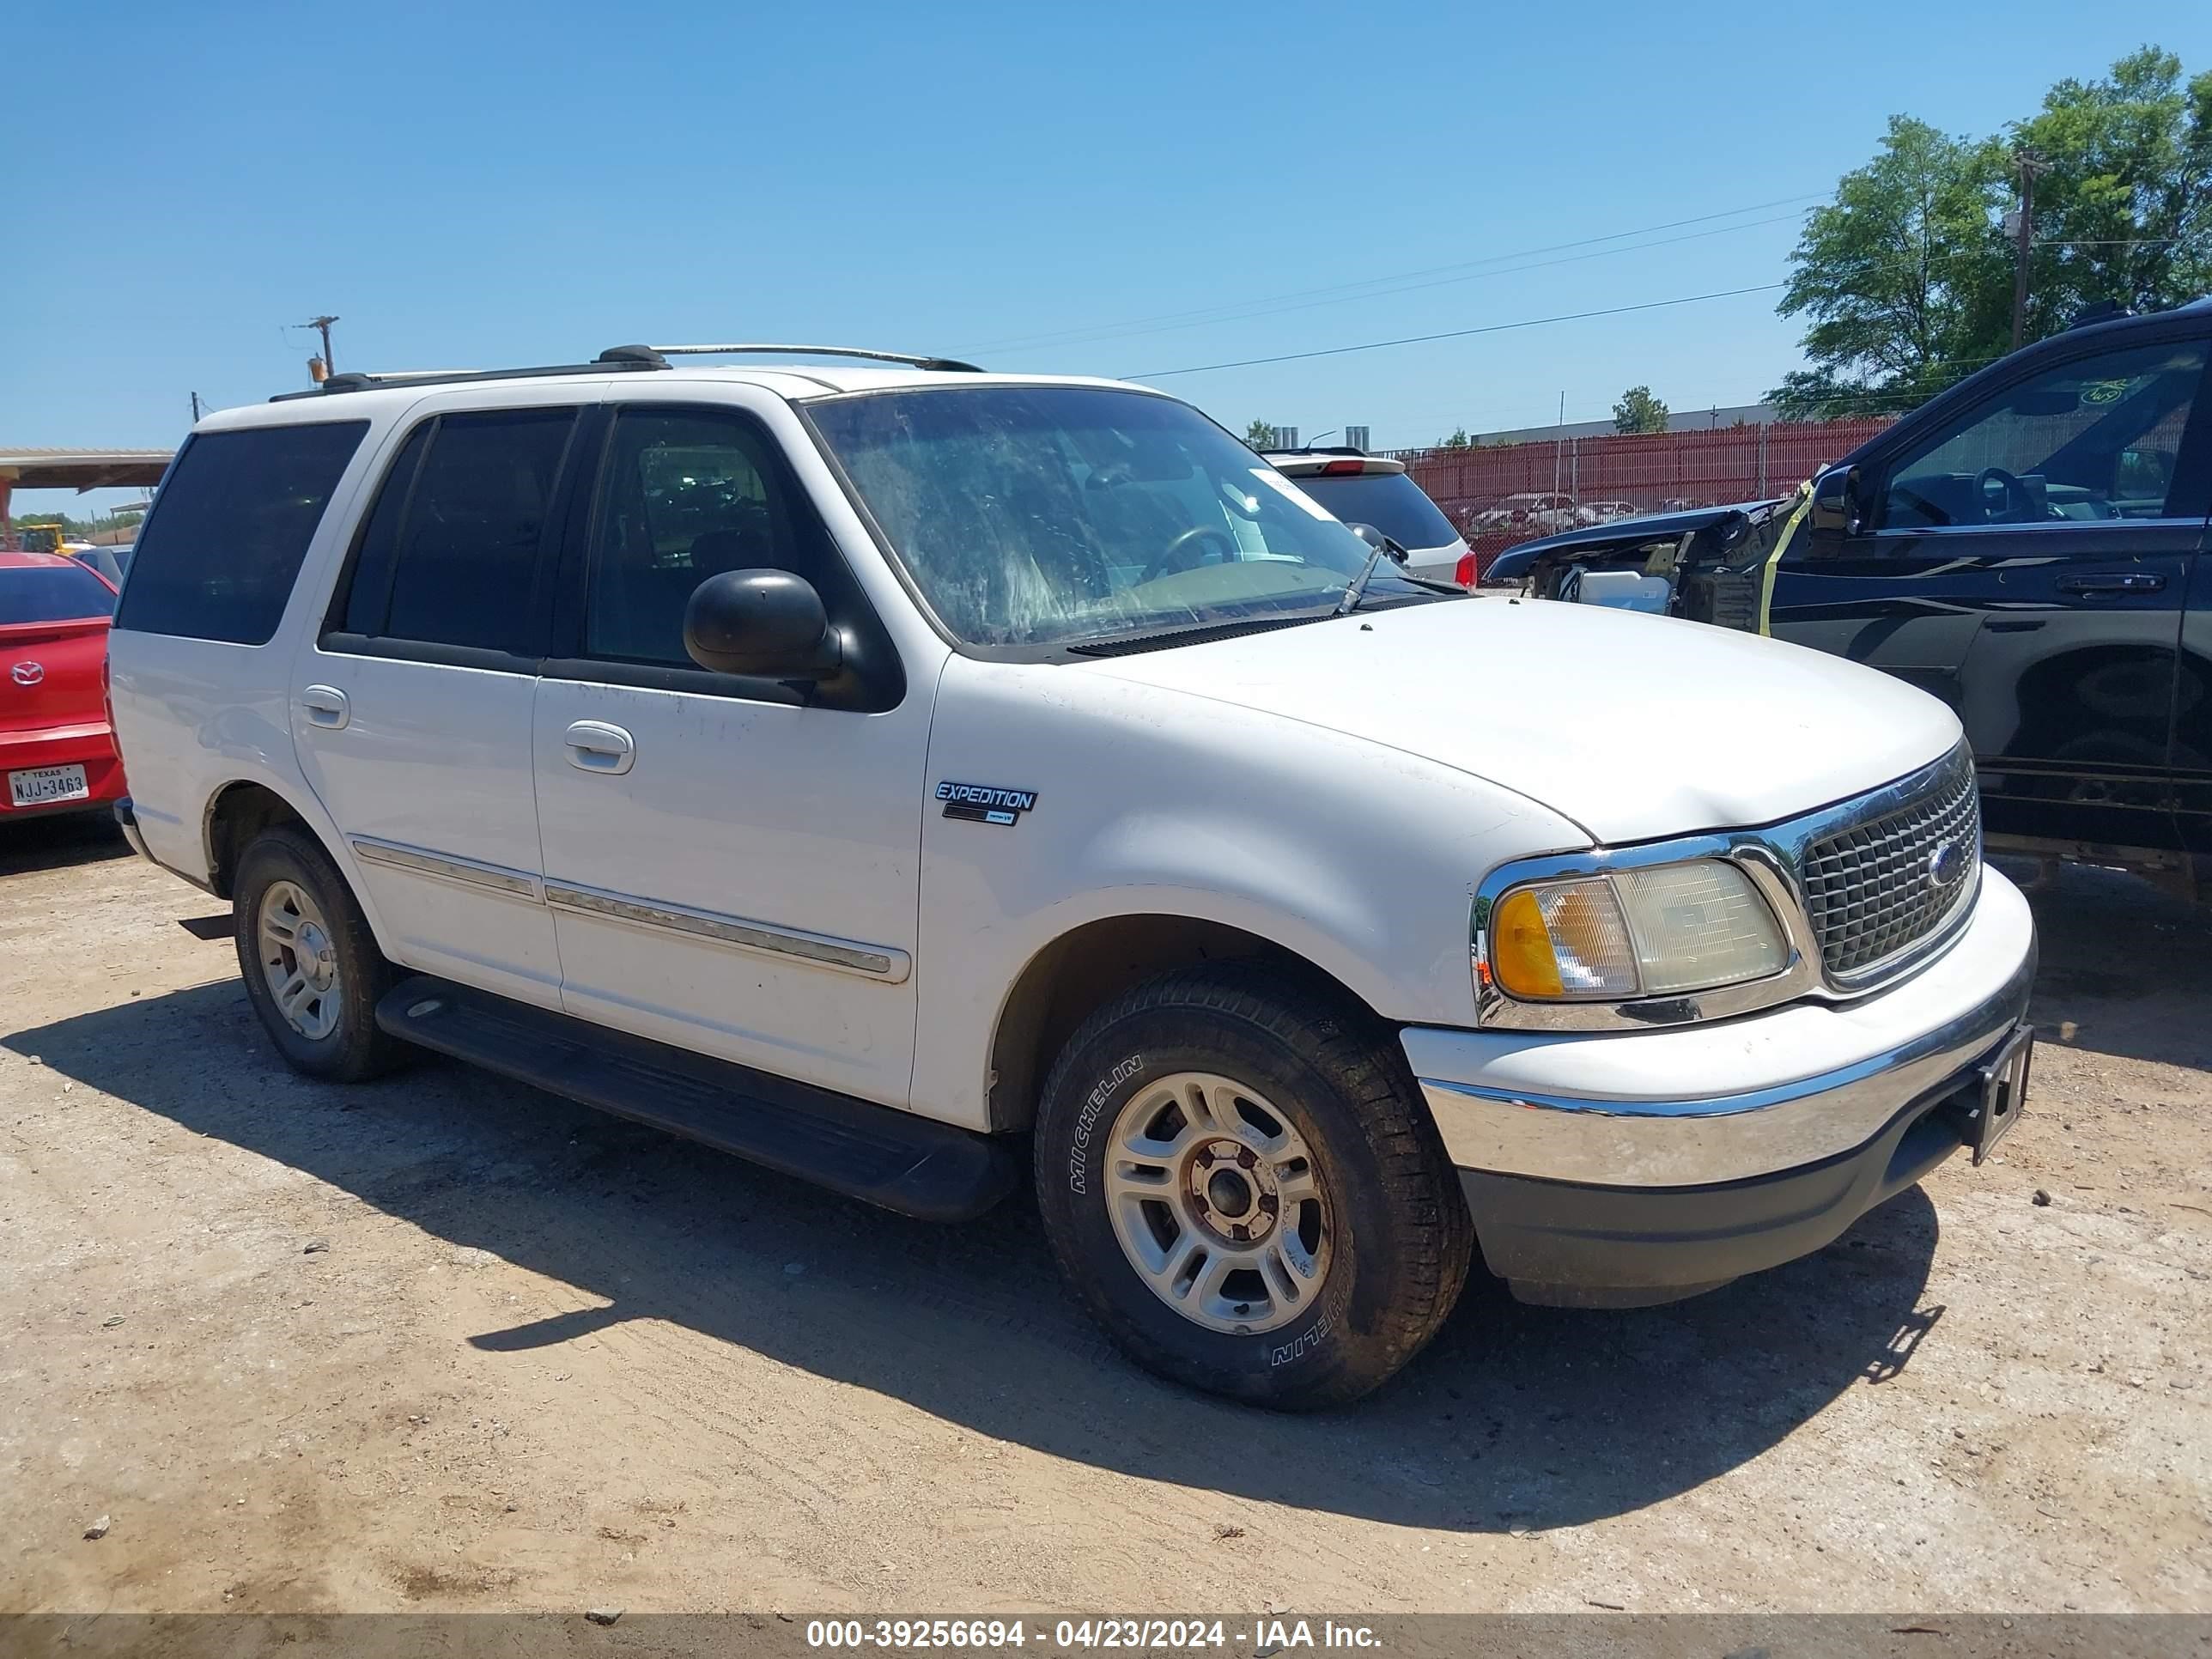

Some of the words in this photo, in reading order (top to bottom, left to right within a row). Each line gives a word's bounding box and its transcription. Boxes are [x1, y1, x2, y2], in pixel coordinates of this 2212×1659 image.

[33, 769, 62, 779] TEXAS
[936, 783, 1033, 809] EXPEDITION
[1070, 1054, 1145, 1194] MICHELIN
